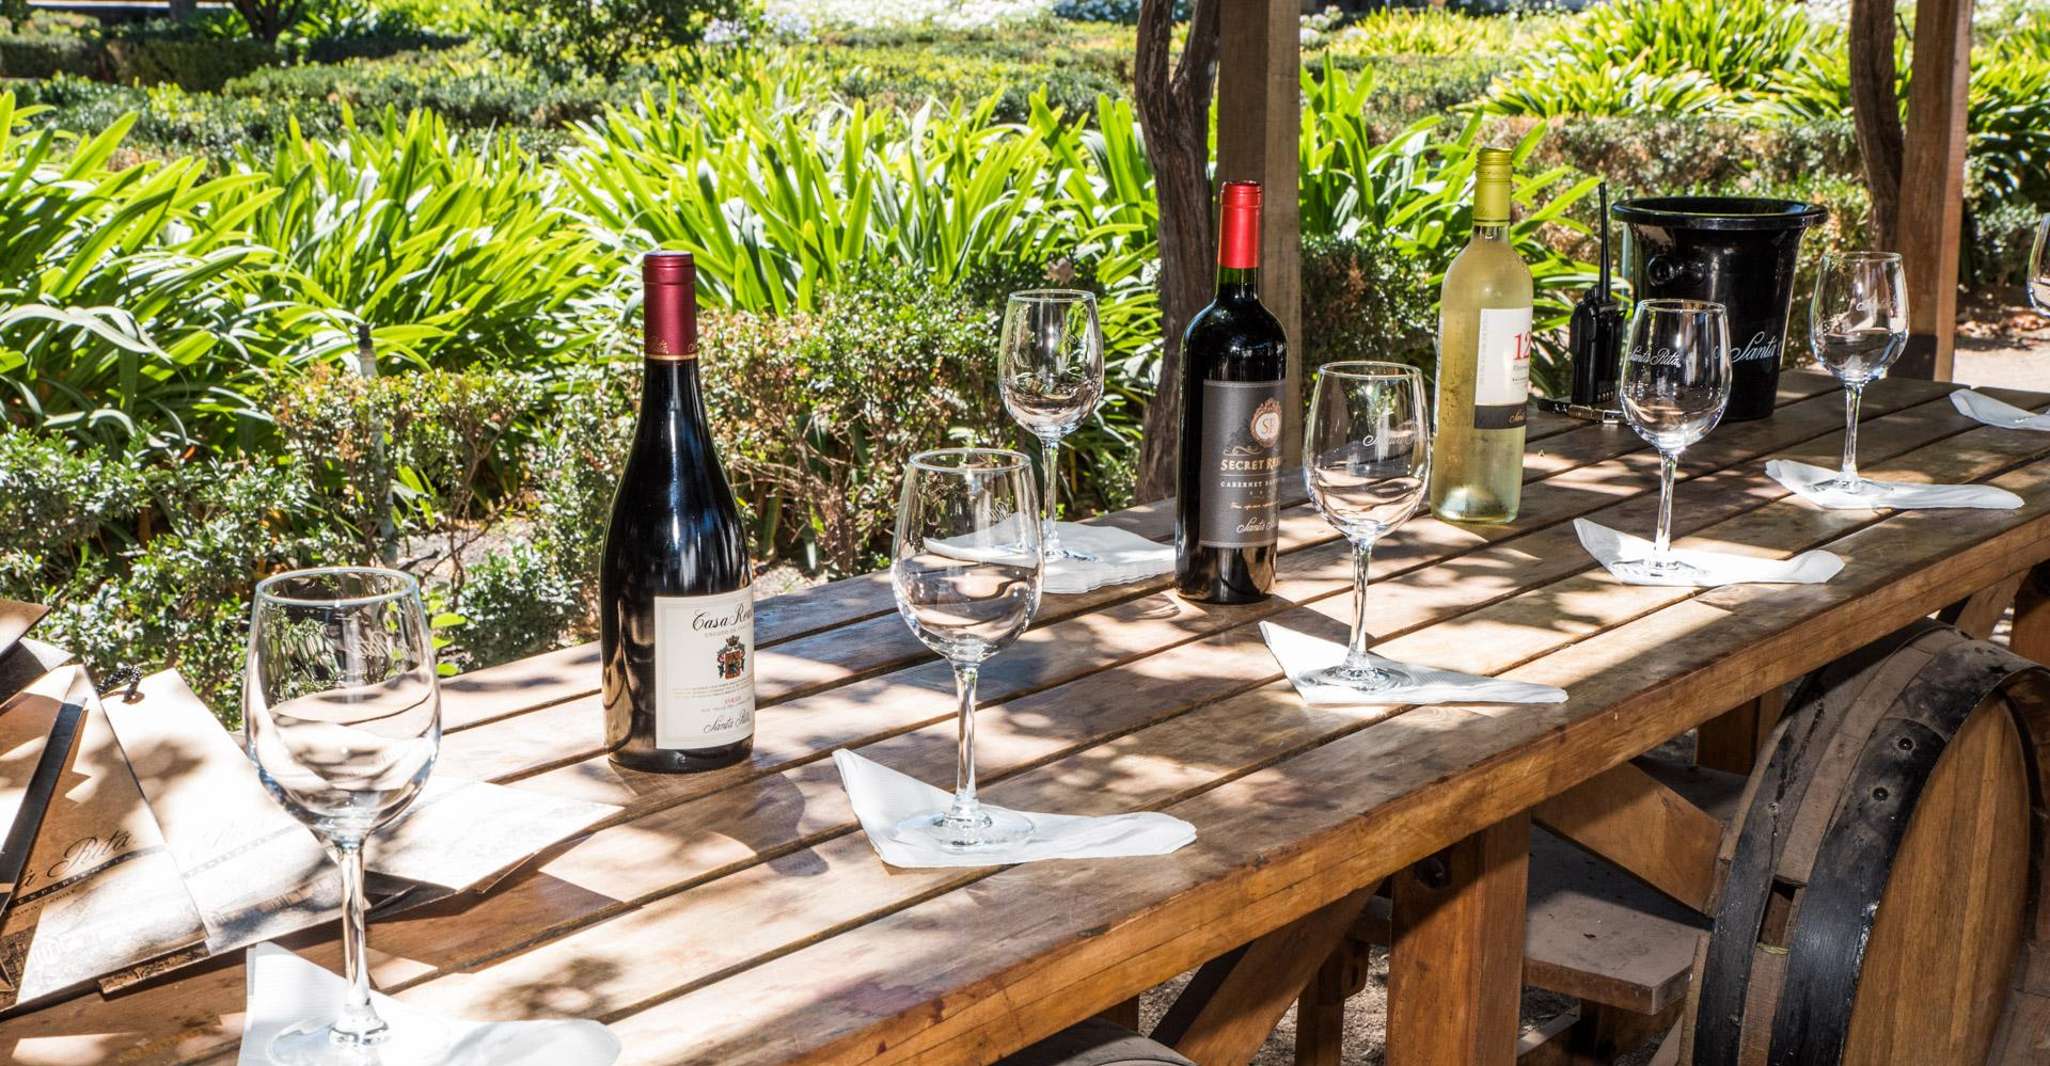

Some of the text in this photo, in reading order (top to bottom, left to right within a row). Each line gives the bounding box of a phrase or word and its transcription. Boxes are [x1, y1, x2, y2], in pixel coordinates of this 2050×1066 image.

[1651, 347, 1681, 368] Rita
[1730, 331, 1776, 363] Santa
[1220, 459, 1265, 471] SECRET
[1220, 480, 1263, 488] CABERNET
[693, 609, 729, 631] Casa
